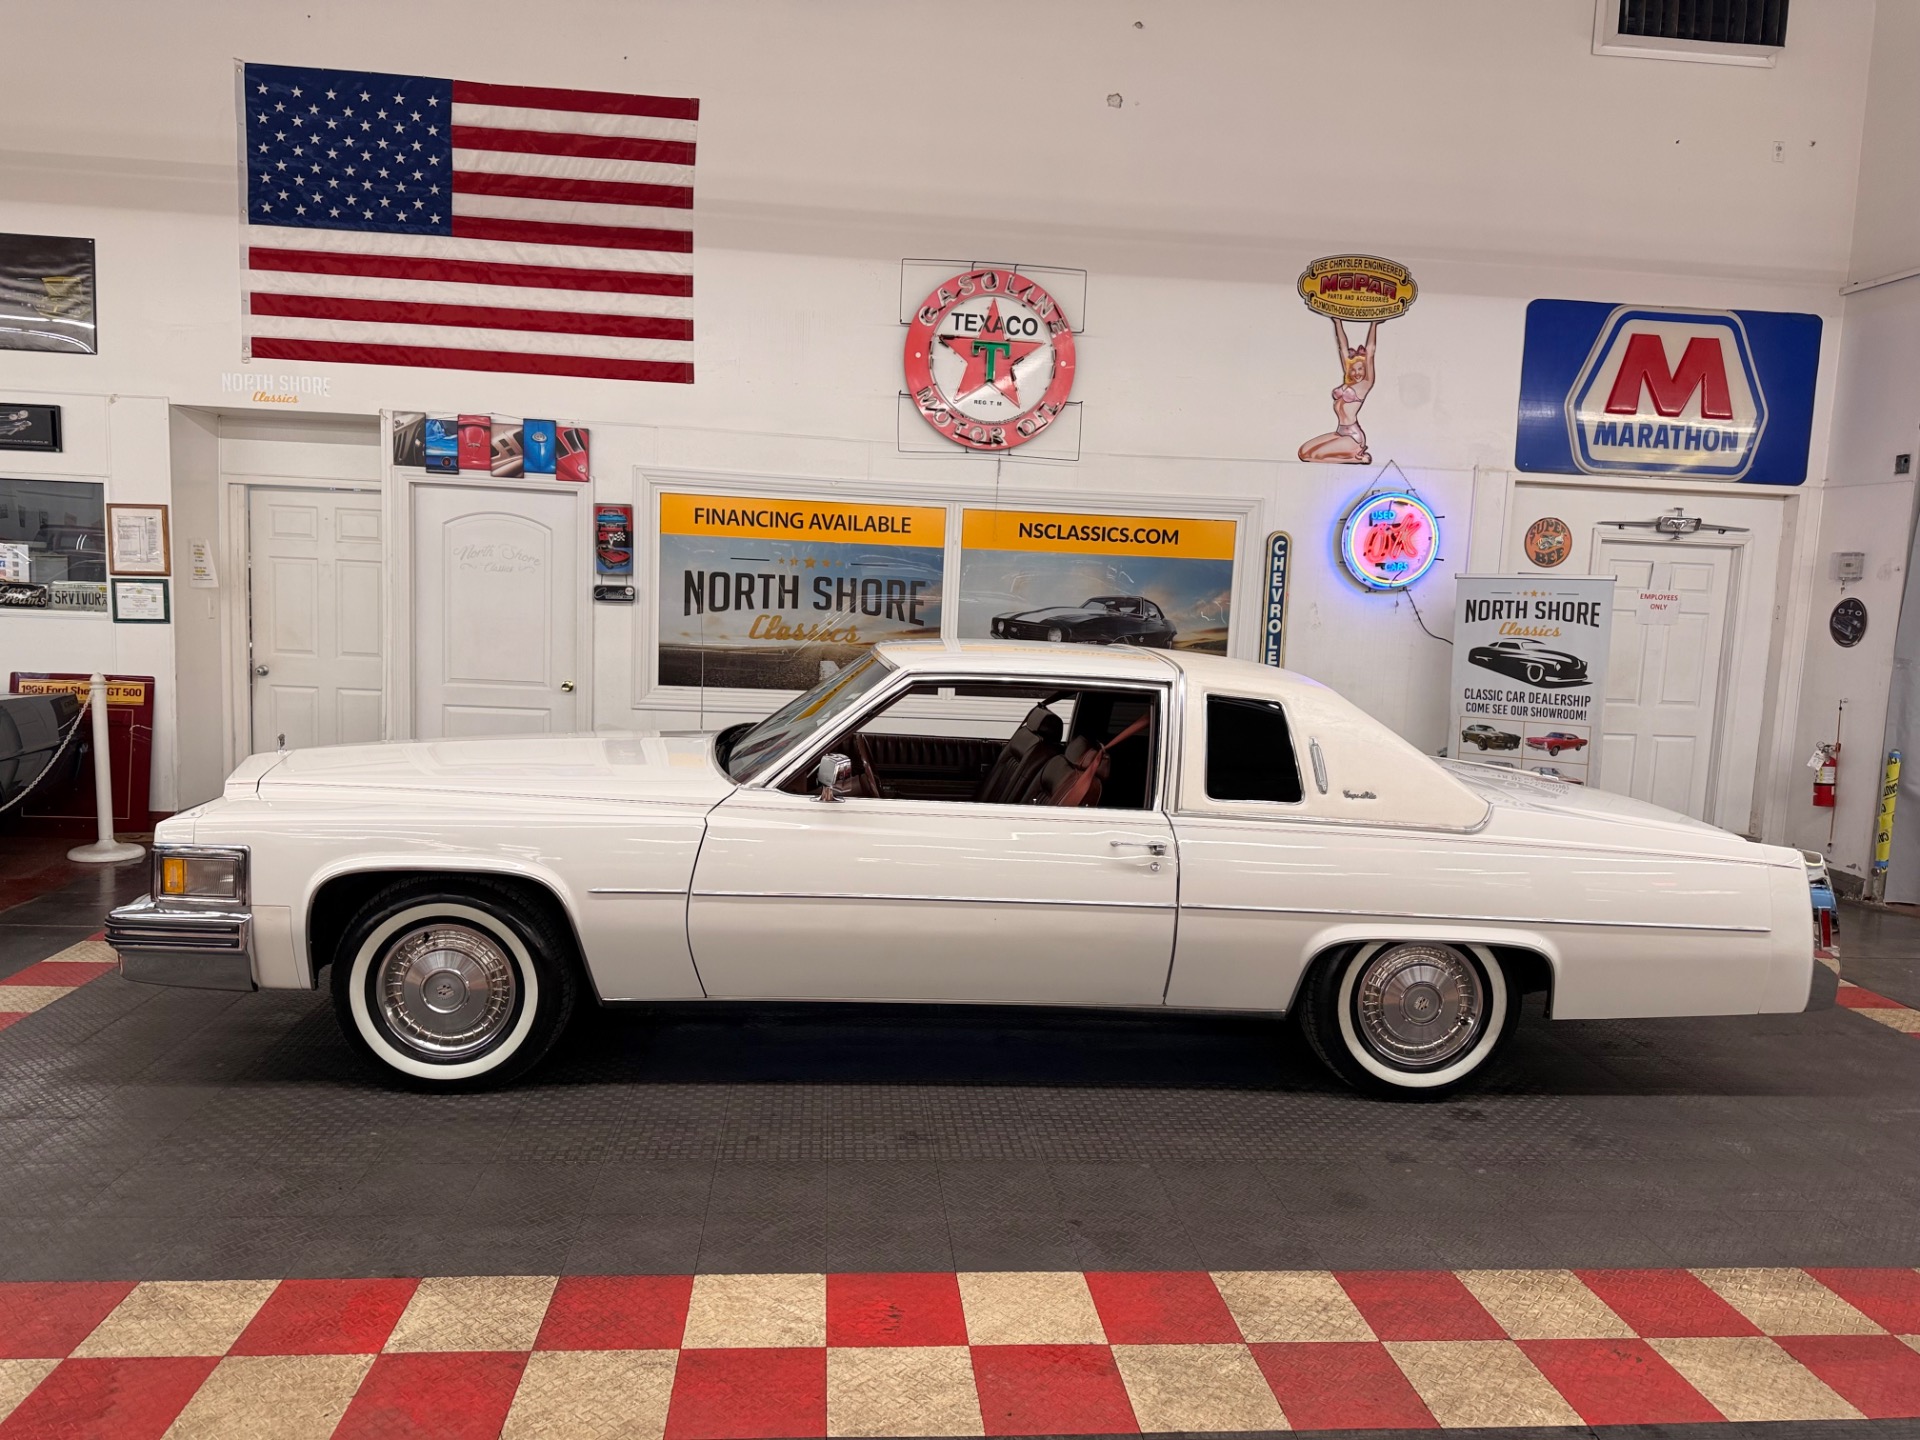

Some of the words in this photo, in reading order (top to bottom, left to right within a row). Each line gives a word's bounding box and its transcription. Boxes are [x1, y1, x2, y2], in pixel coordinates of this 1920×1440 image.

[1315, 263, 1329, 272] USE
[1330, 259, 1363, 269] CHRYSLER
[1364, 260, 1403, 277] ENGINEERED
[1320, 273, 1398, 300] MOPAR
[918, 271, 1069, 338] GASOLINE
[1356, 295, 1390, 303] ACCESSORIES
[951, 312, 1038, 336] TEXACO
[971, 340, 1011, 384] T
[221, 373, 274, 392] NORTH
[280, 375, 332, 398] SHORE
[1604, 332, 1734, 420] M
[252, 391, 299, 404] Classics
[917, 386, 1008, 447] MOTOR
[1016, 402, 1062, 438] OIL
[1593, 422, 1739, 452] MARATHON
[694, 507, 804, 530] FINANCING
[809, 512, 912, 533] AVAILABLE
[1371, 510, 1396, 520] USED
[1018, 522, 1180, 546] NSCLASSICS.COM
[453, 544, 495, 561] North
[498, 543, 542, 566] Shore
[1384, 561, 1408, 571] CARS
[55, 591, 101, 606] SRVIVOR
[684, 570, 800, 616] NORTH
[812, 577, 926, 627] SHORE
[1267, 541, 1287, 665] CHEVROLE
[1640, 593, 1679, 601] EMPLOYEES
[1465, 599, 1528, 624] NORTH
[1534, 601, 1602, 628] SHORE
[1838, 608, 1862, 616] GTO
[748, 614, 861, 645] Classics
[1498, 621, 1562, 637] Classics
[46, 685, 69, 694] Ford
[71, 686, 92, 695] She
[108, 687, 122, 696] GT
[123, 688, 142, 697] 500
[1464, 688, 1503, 702] CLASSIC
[1506, 690, 1526, 703] CAR
[1528, 692, 1592, 707] DEALERSHIP
[1465, 702, 1490, 713] COME
[1492, 703, 1509, 715] SEE
[1510, 705, 1529, 716] OUR
[1530, 707, 1587, 721] SHOWROOM!
